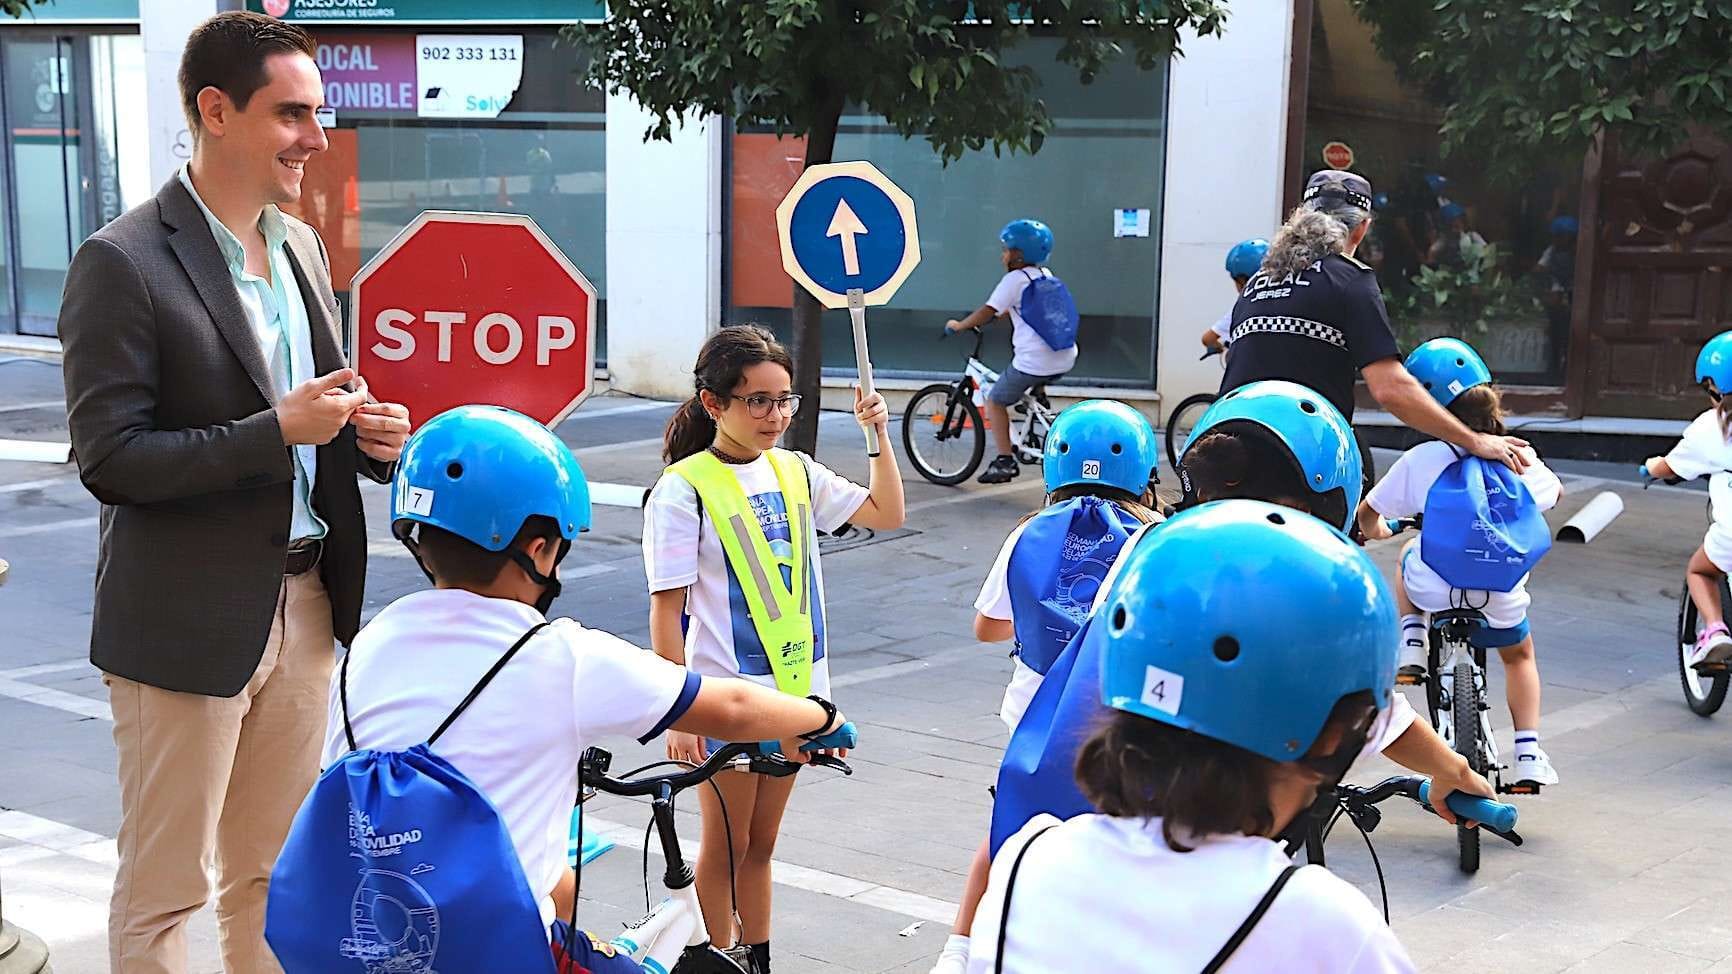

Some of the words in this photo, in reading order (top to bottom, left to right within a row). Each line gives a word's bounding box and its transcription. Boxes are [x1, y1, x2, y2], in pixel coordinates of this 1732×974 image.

[347, 8, 357, 18] DE
[359, 8, 395, 17] SEGUROS
[422, 47, 450, 60] 902
[456, 48, 483, 60] 333
[489, 48, 517, 60] 131
[324, 81, 413, 109] ONIBLE
[1250, 287, 1292, 302] JEREZ
[370, 308, 576, 366] STOP
[1083, 463, 1098, 475] 20
[413, 492, 422, 509] 7
[1150, 680, 1166, 703] 4
[363, 829, 422, 849] OVILIDAD
